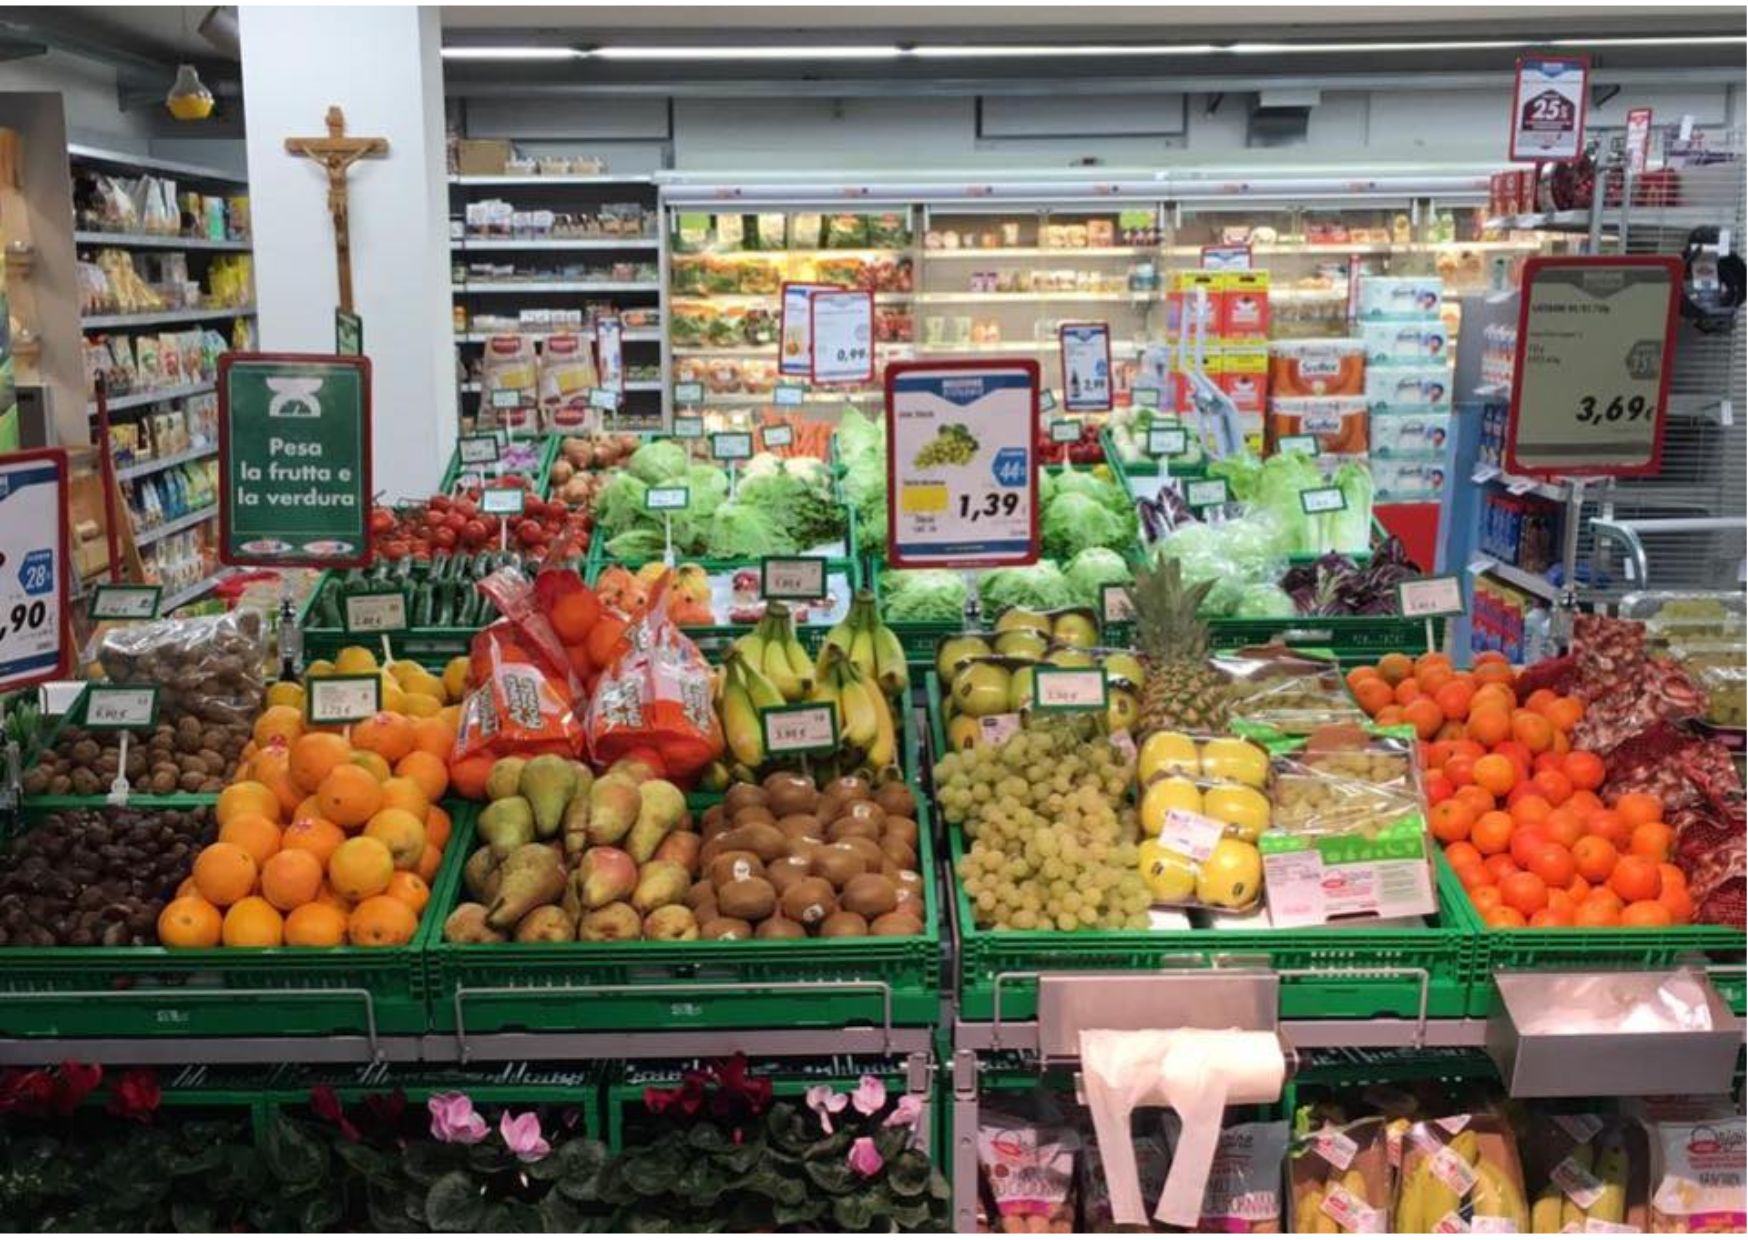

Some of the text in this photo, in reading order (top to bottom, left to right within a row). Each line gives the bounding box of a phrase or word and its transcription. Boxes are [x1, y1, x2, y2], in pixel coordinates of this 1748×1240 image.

[1532, 99, 1560, 120] 25
[269, 438, 323, 457] Pesa
[240, 461, 351, 482] la frutta e
[238, 487, 355, 508] la verdura
[960, 492, 1019, 522] 1,39
[25, 565, 45, 590] 28
